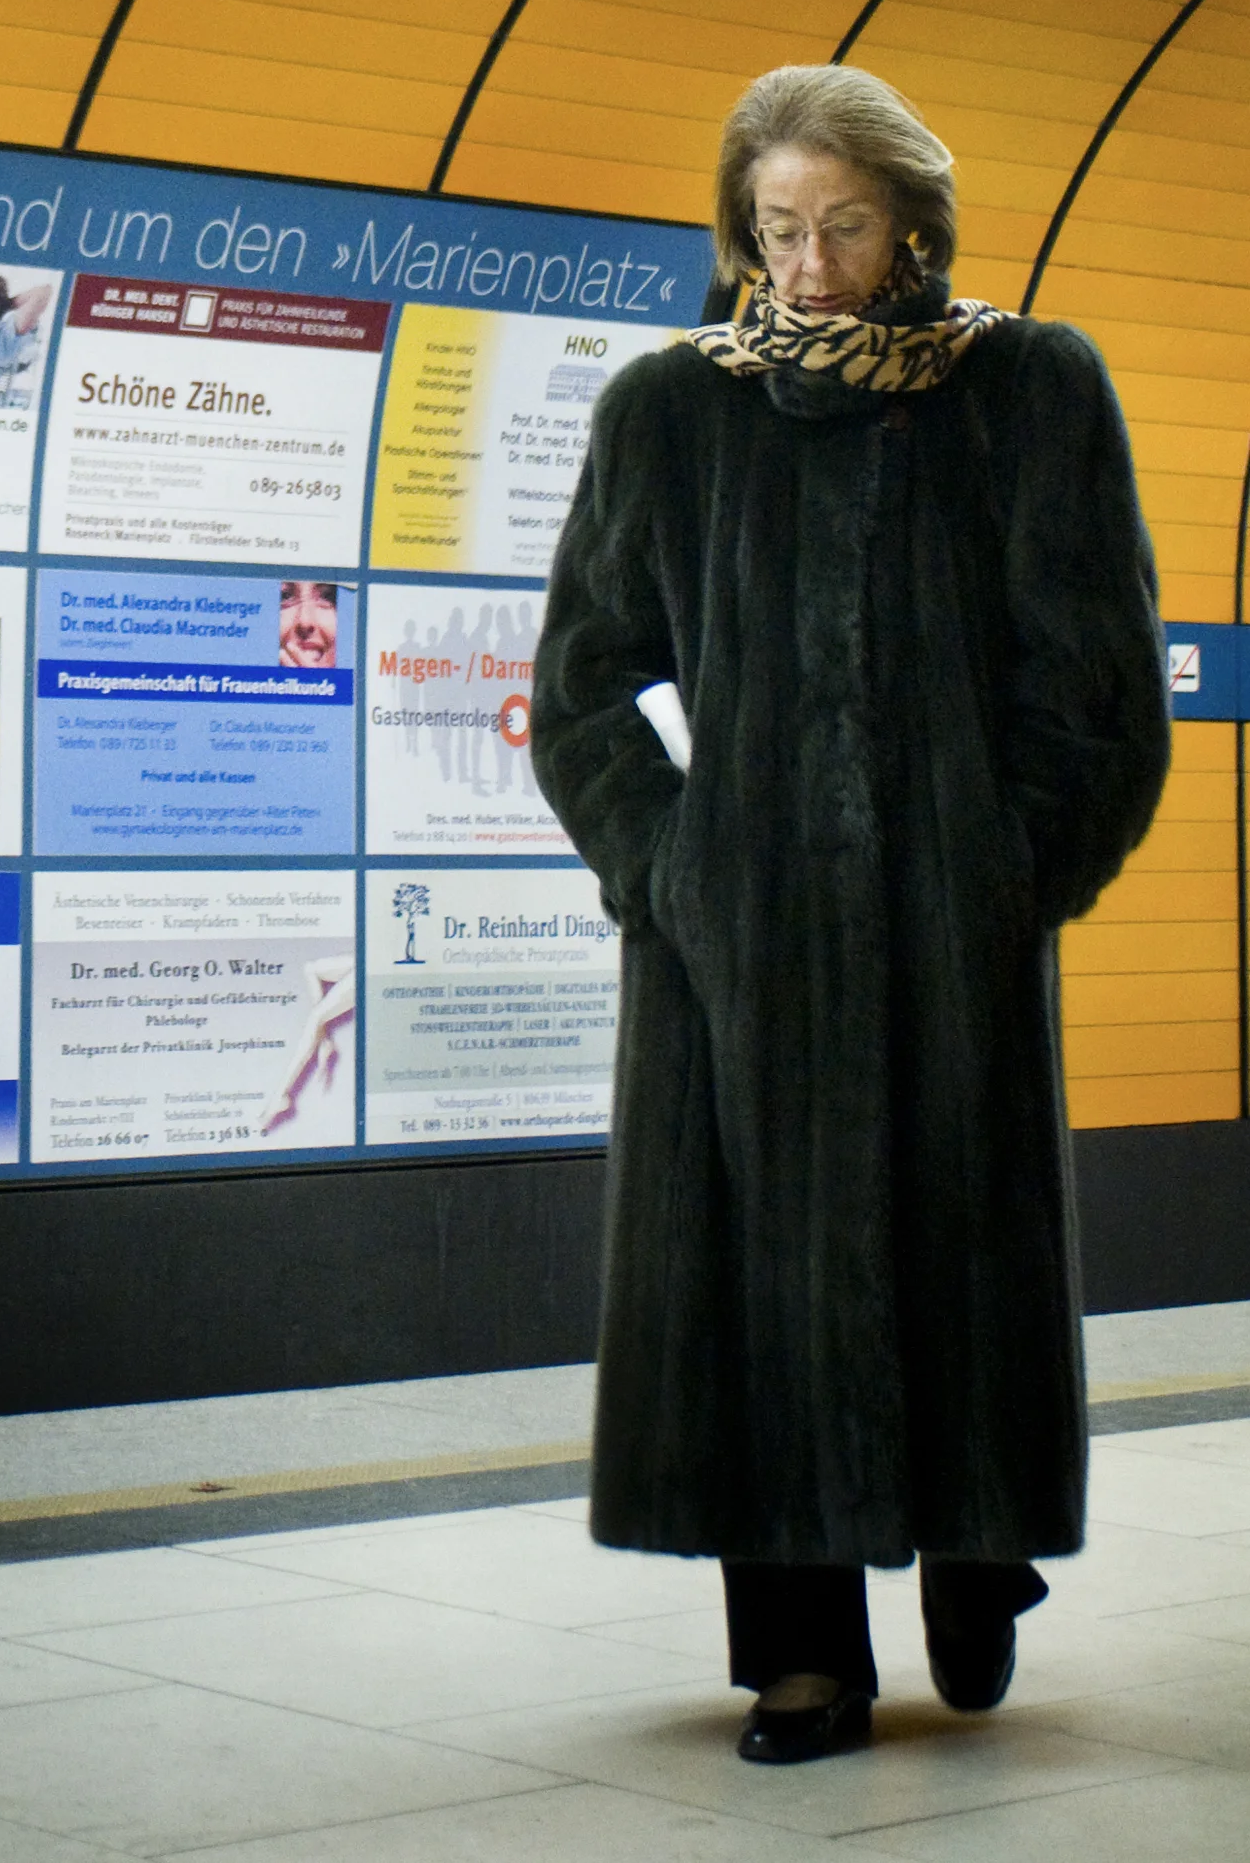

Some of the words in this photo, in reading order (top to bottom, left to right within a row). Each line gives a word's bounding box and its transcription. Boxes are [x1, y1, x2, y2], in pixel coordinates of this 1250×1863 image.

[79, 210, 171, 263] um
[194, 204, 309, 277] den
[330, 219, 677, 314] »Marienplatz«
[564, 335, 609, 359] HNO
[78, 372, 176, 410] Schöne
[186, 381, 273, 417] Zähne.
[510, 412, 533, 428] Prof.
[536, 414, 549, 429] Dr.
[553, 417, 579, 430] med.
[72, 425, 345, 457] www.zahnarzt-muenchen-zentrum.de
[500, 430, 521, 446] Prof.
[525, 432, 539, 446] Dr.
[542, 435, 569, 449] med.
[508, 450, 522, 464] Dr.
[524, 452, 552, 467] med.
[555, 453, 575, 467] Eva
[128, 517, 147, 529] und
[150, 517, 167, 530] alle
[507, 515, 543, 529] Telefon
[60, 591, 81, 608] Dr.
[84, 593, 118, 609] med.
[121, 593, 191, 613] Alexandra
[194, 596, 262, 618] Kleberger
[60, 615, 81, 632] Dr.
[83, 618, 118, 633] med.
[120, 618, 173, 636] Claudia
[176, 620, 249, 638] Macrander
[379, 650, 461, 684] Magen-
[57, 671, 197, 694] Praxisgemeinschaft
[199, 674, 220, 693] für
[221, 675, 337, 697] Frauenheilkunde
[371, 705, 514, 733] Gastroenterologie
[443, 916, 472, 939] Dr.
[478, 914, 558, 939] Reinhard
[565, 913, 620, 944] Dingle
[71, 962, 99, 979] Dr.
[104, 961, 144, 979] med.
[150, 960, 200, 981] Georg
[204, 959, 223, 976] O.
[228, 958, 284, 976] Walter
[51, 996, 103, 1009] Facharzt
[106, 995, 125, 1008] für
[127, 994, 184, 1009] Chirurgie
[186, 993, 208, 1005] und
[210, 991, 298, 1006] Gefäßchirurgie
[61, 1043, 118, 1058] Belegarzt
[120, 1042, 140, 1054] der
[142, 1039, 213, 1054] Privatklinik
[217, 1037, 286, 1054] Josephinum
[50, 1133, 95, 1148] Telefon
[163, 1127, 207, 1144] Telefon
